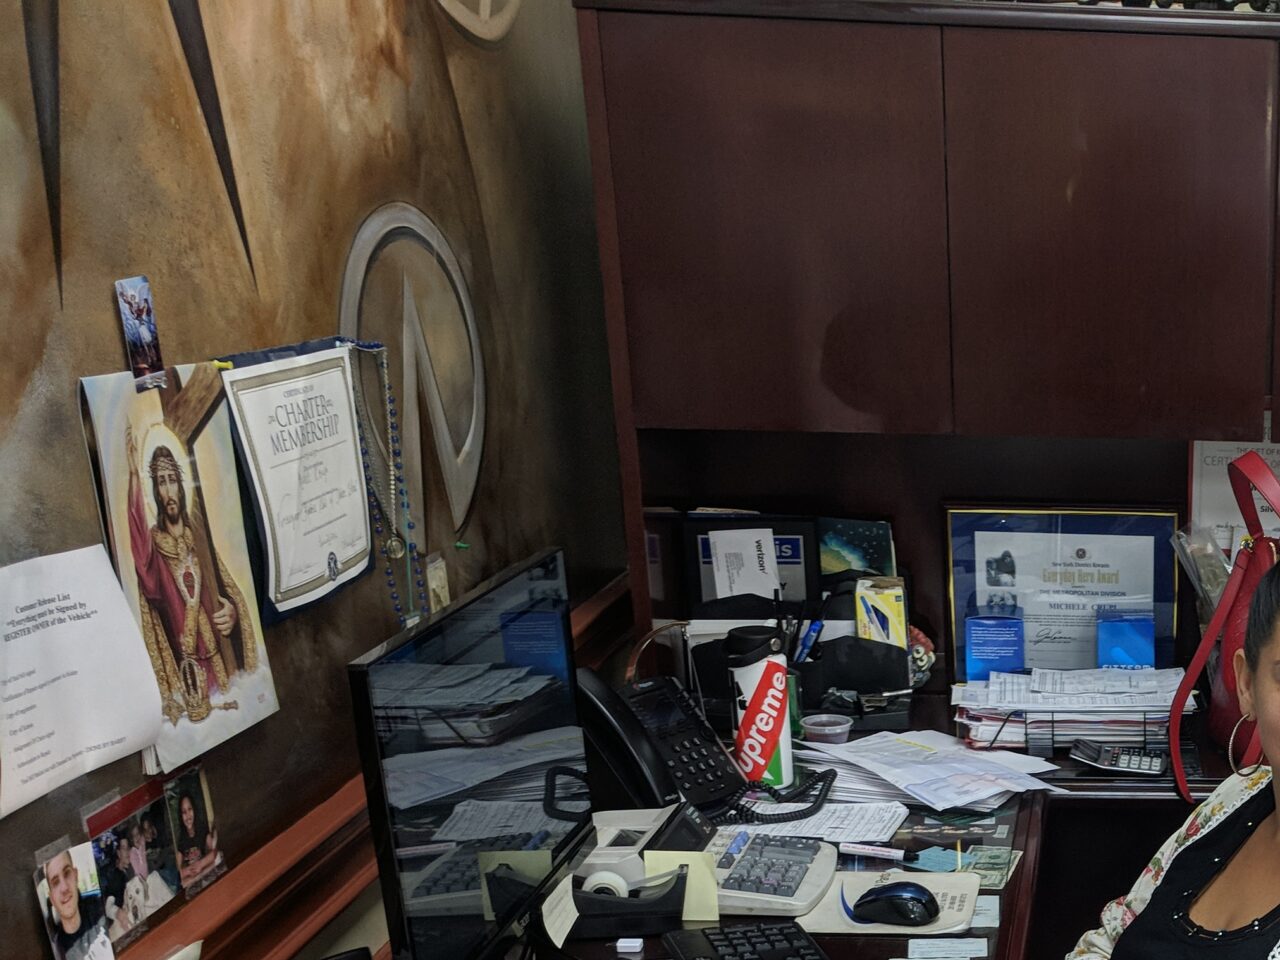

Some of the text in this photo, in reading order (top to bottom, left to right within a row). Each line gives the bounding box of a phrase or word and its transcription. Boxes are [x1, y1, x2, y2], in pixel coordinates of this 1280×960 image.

[274, 394, 331, 428] CHARTER
[270, 414, 341, 456] MEMBERSHIP
[755, 539, 768, 574] verizon
[739, 671, 787, 773] upreme
